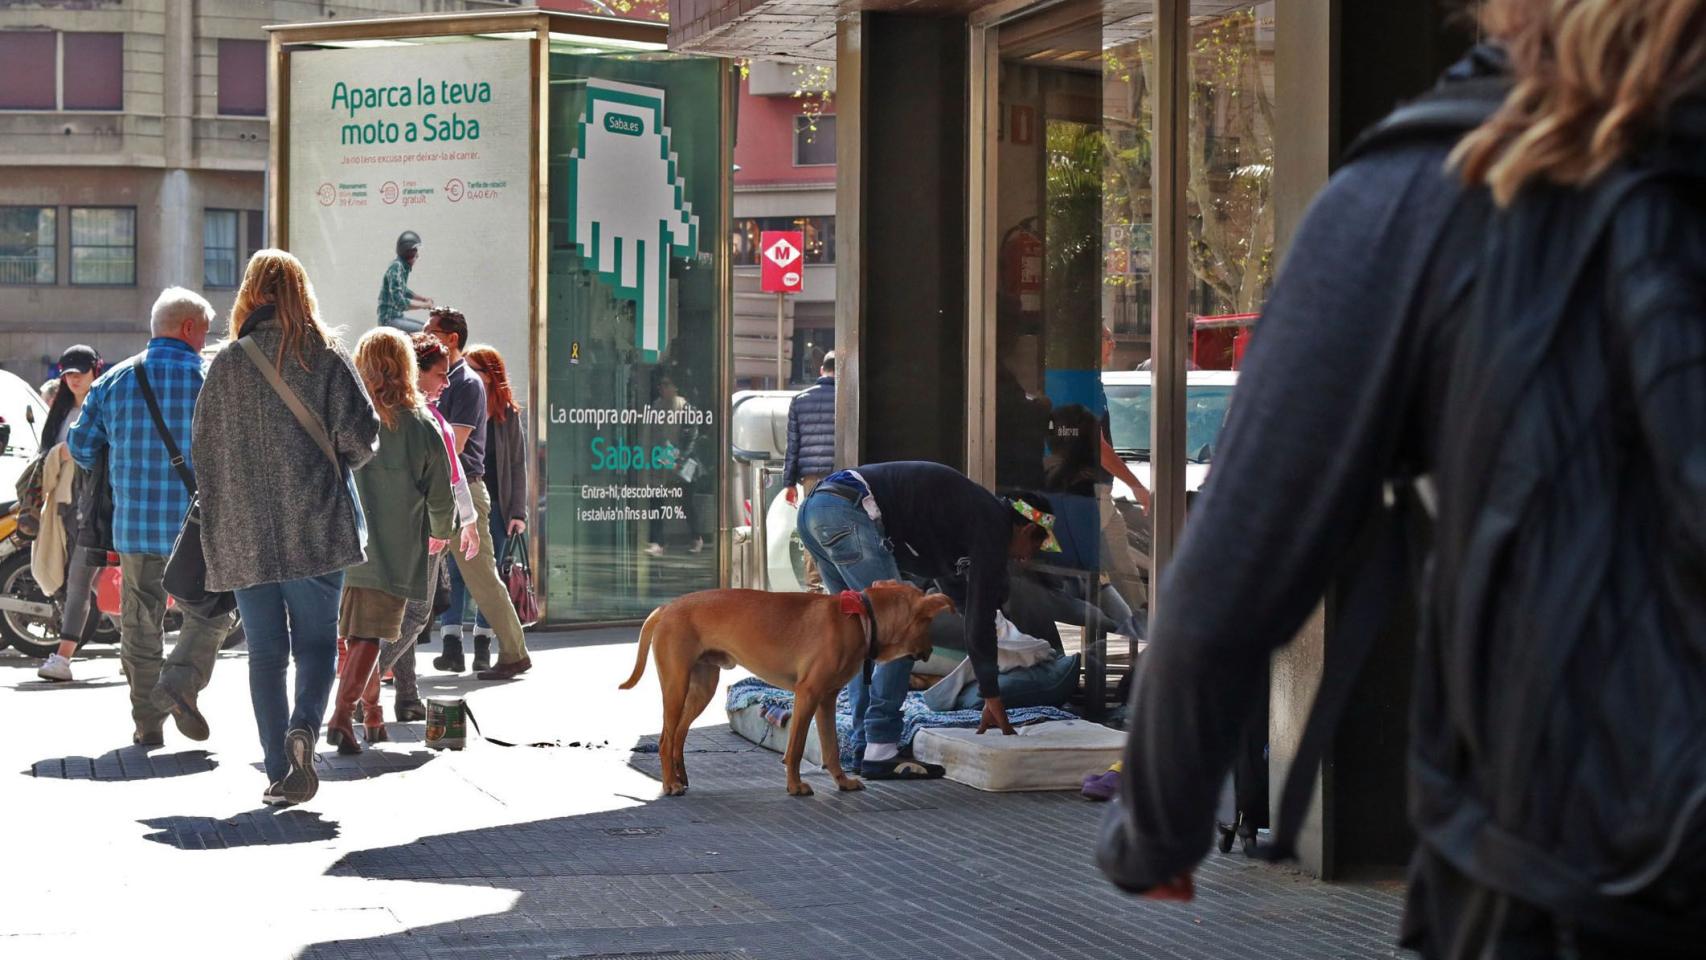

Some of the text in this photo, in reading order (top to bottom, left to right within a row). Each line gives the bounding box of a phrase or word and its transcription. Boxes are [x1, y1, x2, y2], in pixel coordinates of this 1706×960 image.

[331, 78, 492, 118] Aparca la teva
[341, 112, 480, 145] moto a Saba
[608, 115, 639, 132] Saba.es
[340, 155, 349, 165] Ja
[350, 156, 360, 164] no
[378, 154, 402, 163] excusa
[402, 154, 416, 165] per
[416, 152, 448, 162] deixar-la
[449, 151, 456, 161] al
[456, 151, 480, 161] carrer.
[466, 190, 484, 200] 0,40
[775, 246, 790, 260] M
[550, 404, 713, 430] La compra on-line arriba a
[591, 437, 676, 471] Saba.es
[581, 484, 683, 500] Entra-hi, descobreix-no
[577, 506, 687, 522] i estalvia'n fins a un 70 %.
